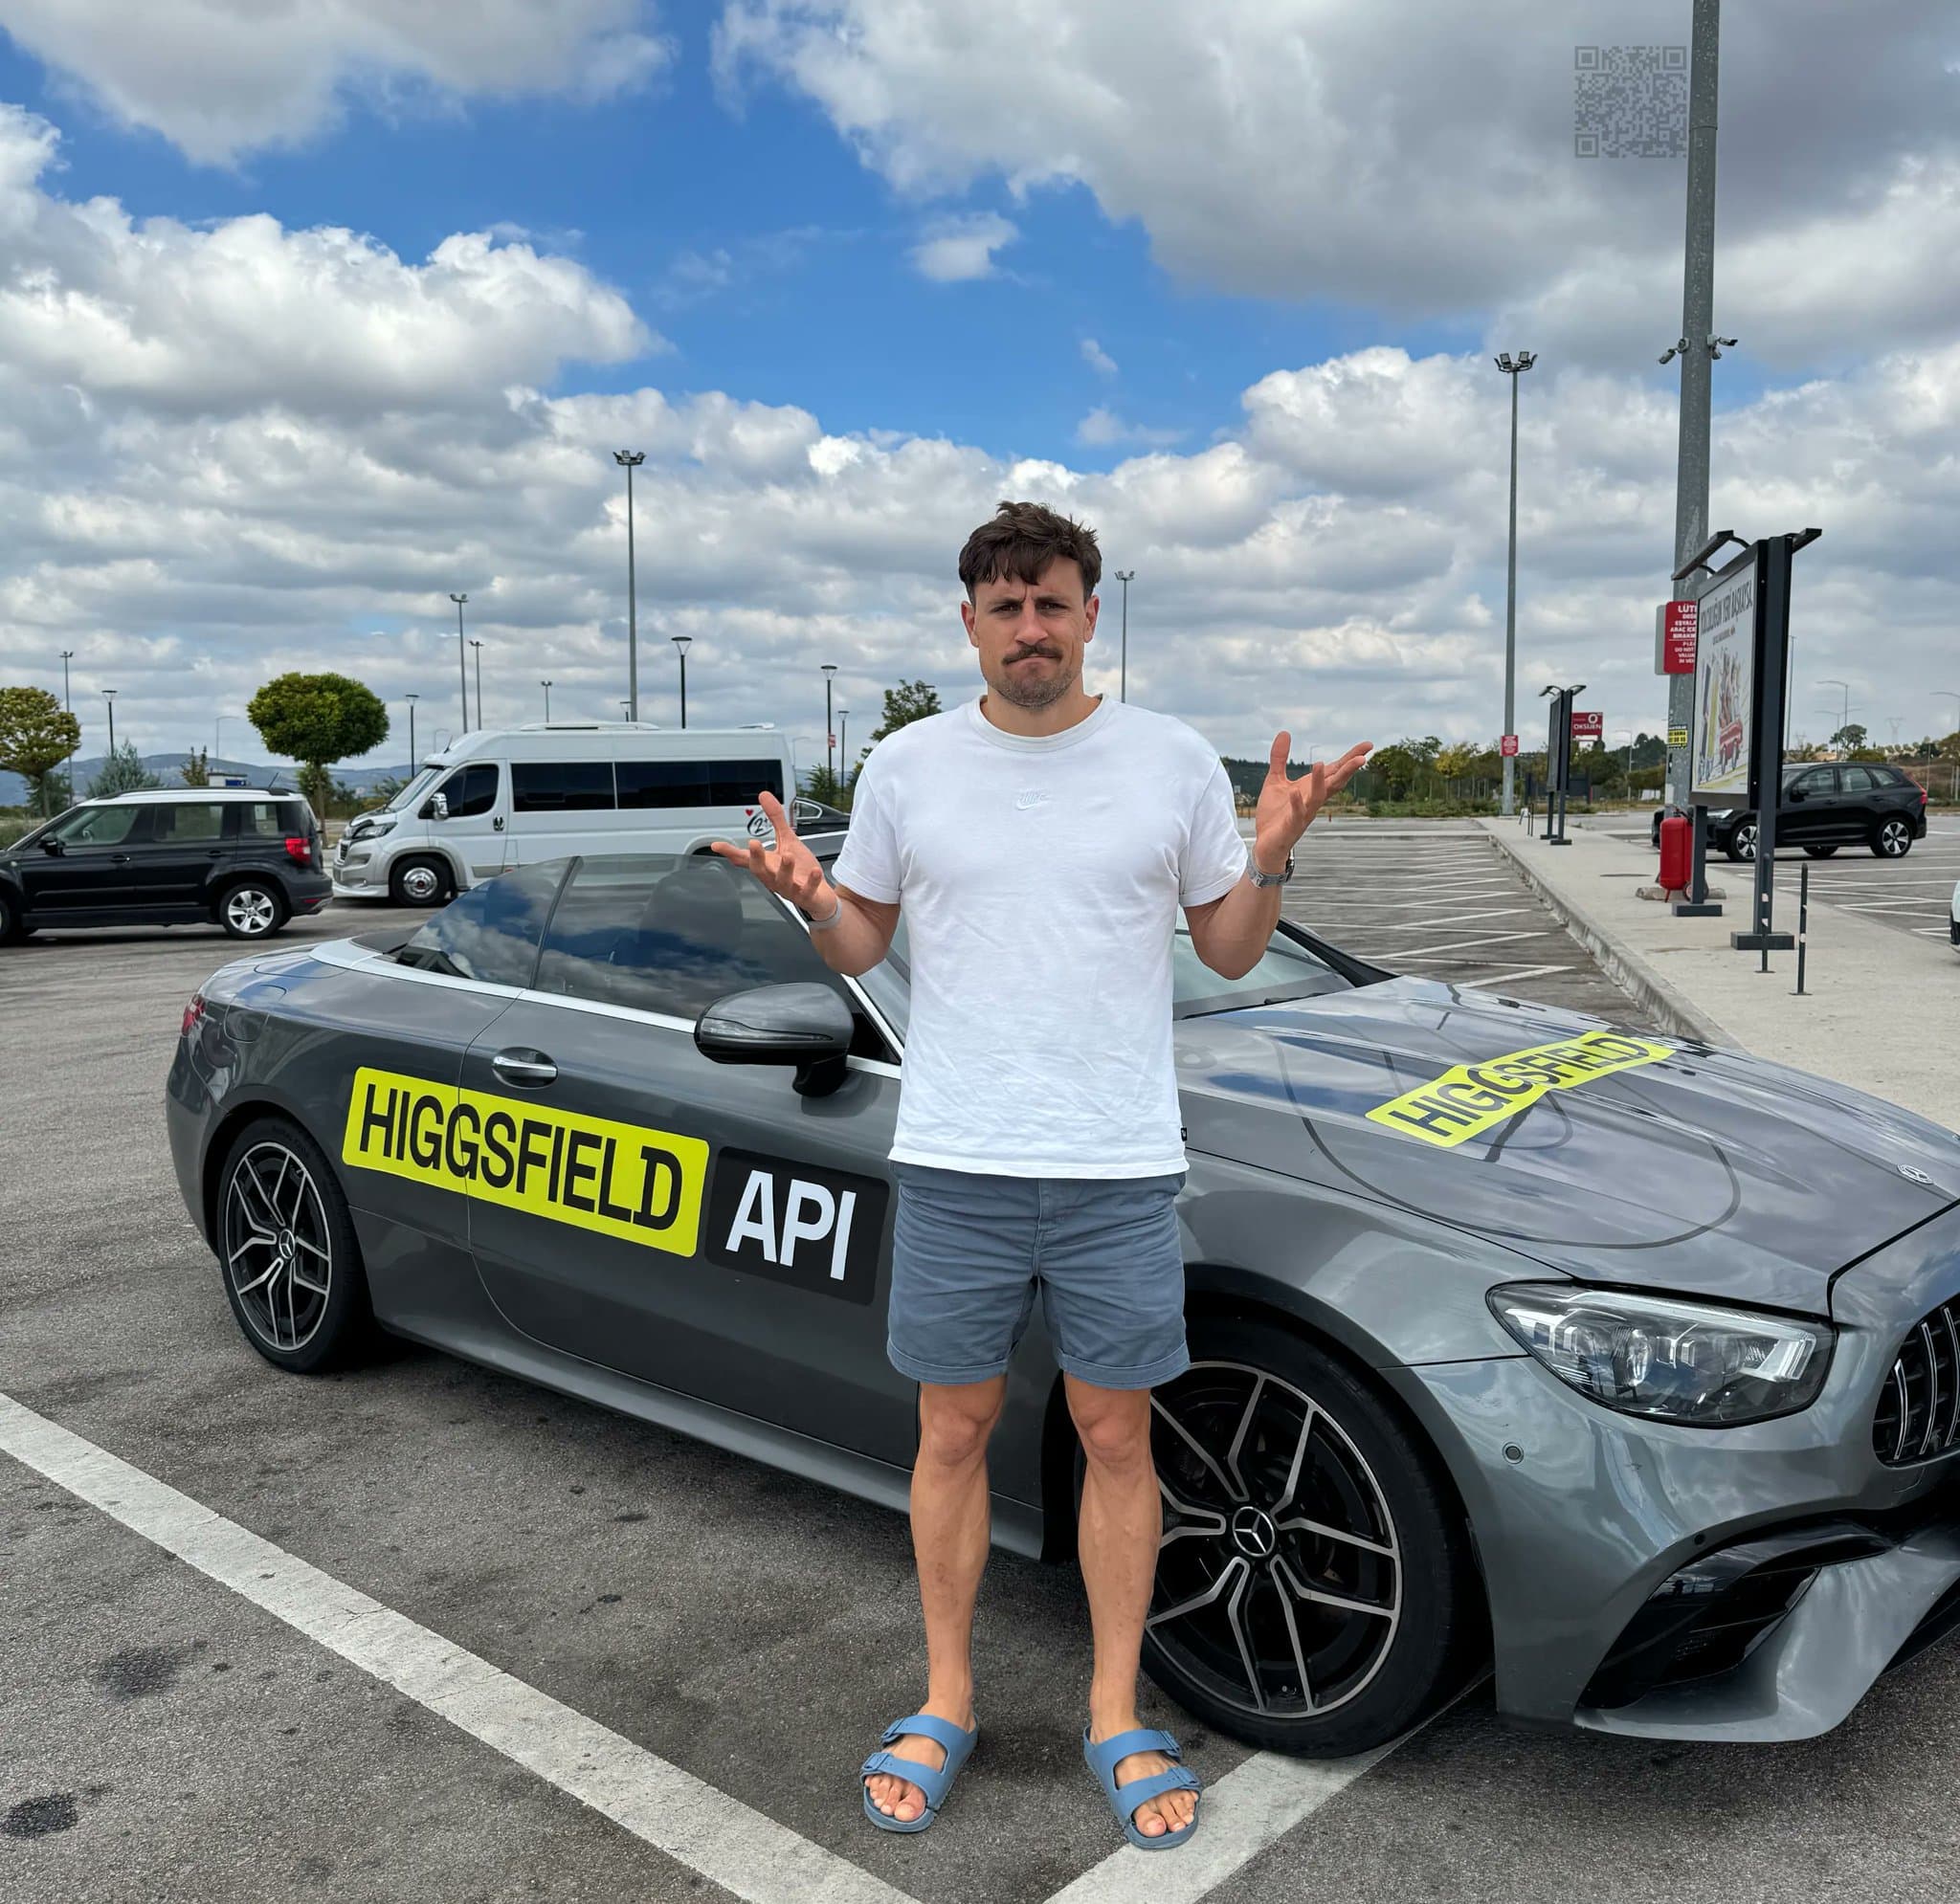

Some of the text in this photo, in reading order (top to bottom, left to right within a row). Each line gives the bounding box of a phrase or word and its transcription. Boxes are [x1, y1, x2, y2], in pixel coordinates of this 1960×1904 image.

[1678, 603, 1697, 612] LÜT
[1388, 1037, 1651, 1138] HIGGSFIELD
[359, 1083, 857, 1281] HIGGSFIELD API
